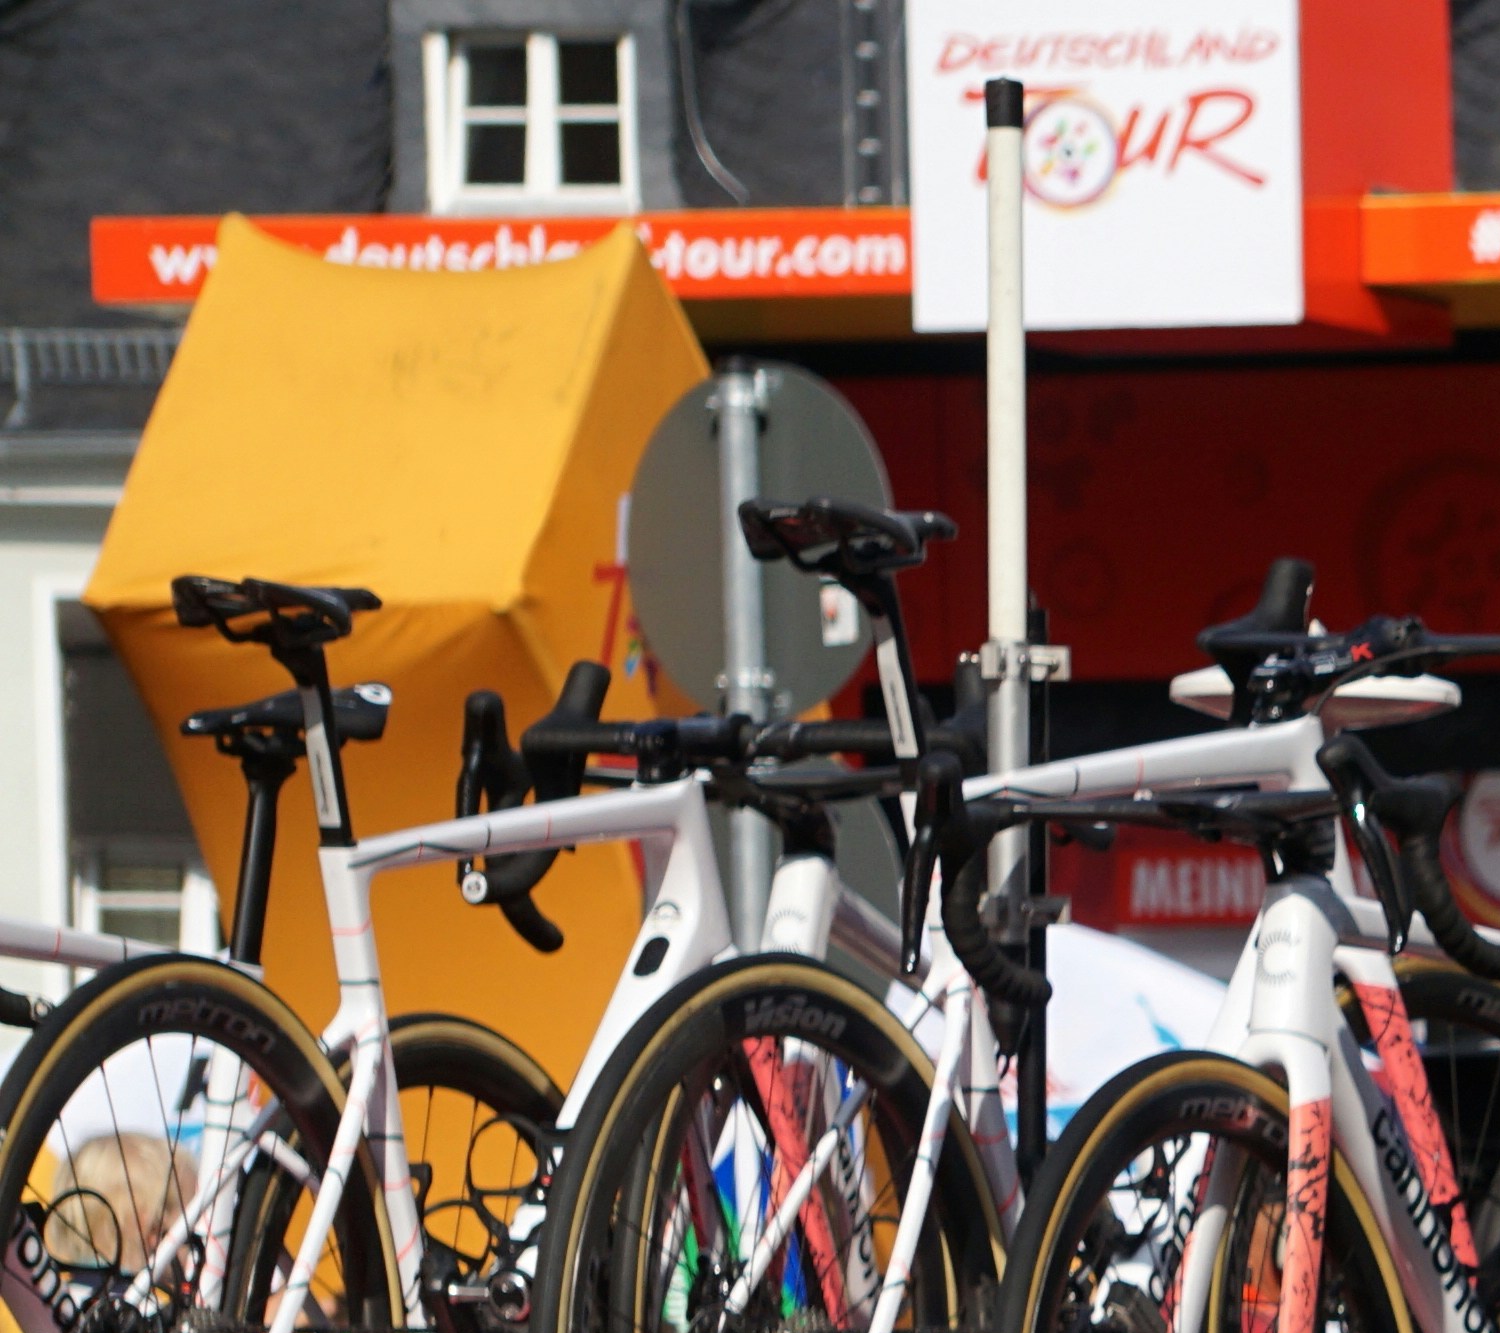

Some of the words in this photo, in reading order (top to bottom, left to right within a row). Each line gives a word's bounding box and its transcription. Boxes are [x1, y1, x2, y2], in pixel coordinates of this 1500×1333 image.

[935, 27, 1281, 75] DEUTSCHLAND
[962, 86, 1268, 210] TOUR
[1129, 856, 1267, 914] MEIN
[1176, 1096, 1292, 1149] metro
